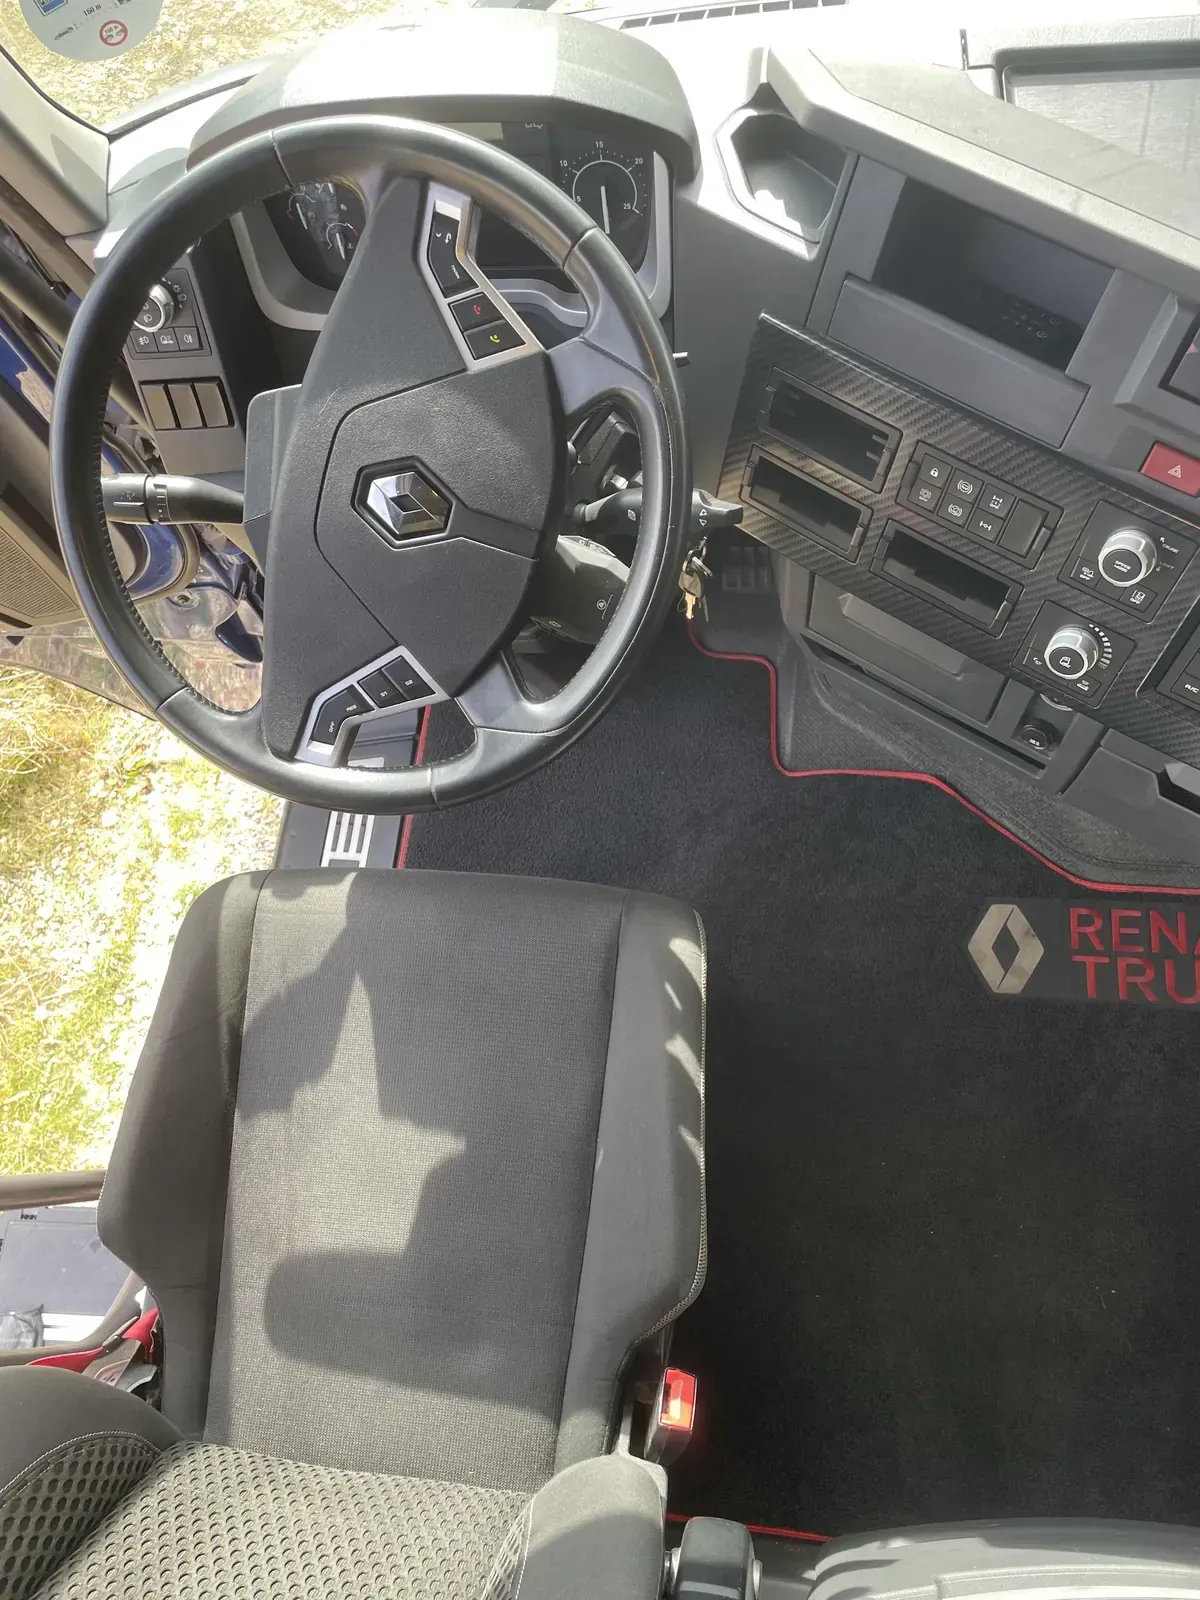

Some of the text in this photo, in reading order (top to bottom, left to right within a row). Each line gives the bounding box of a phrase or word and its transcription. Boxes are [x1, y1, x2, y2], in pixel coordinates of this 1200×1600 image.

[634, 157, 644, 165] 20
[1184, 683, 1200, 694] A/C
[1069, 907, 1200, 954] REN
[1071, 955, 1200, 1004] TRU
